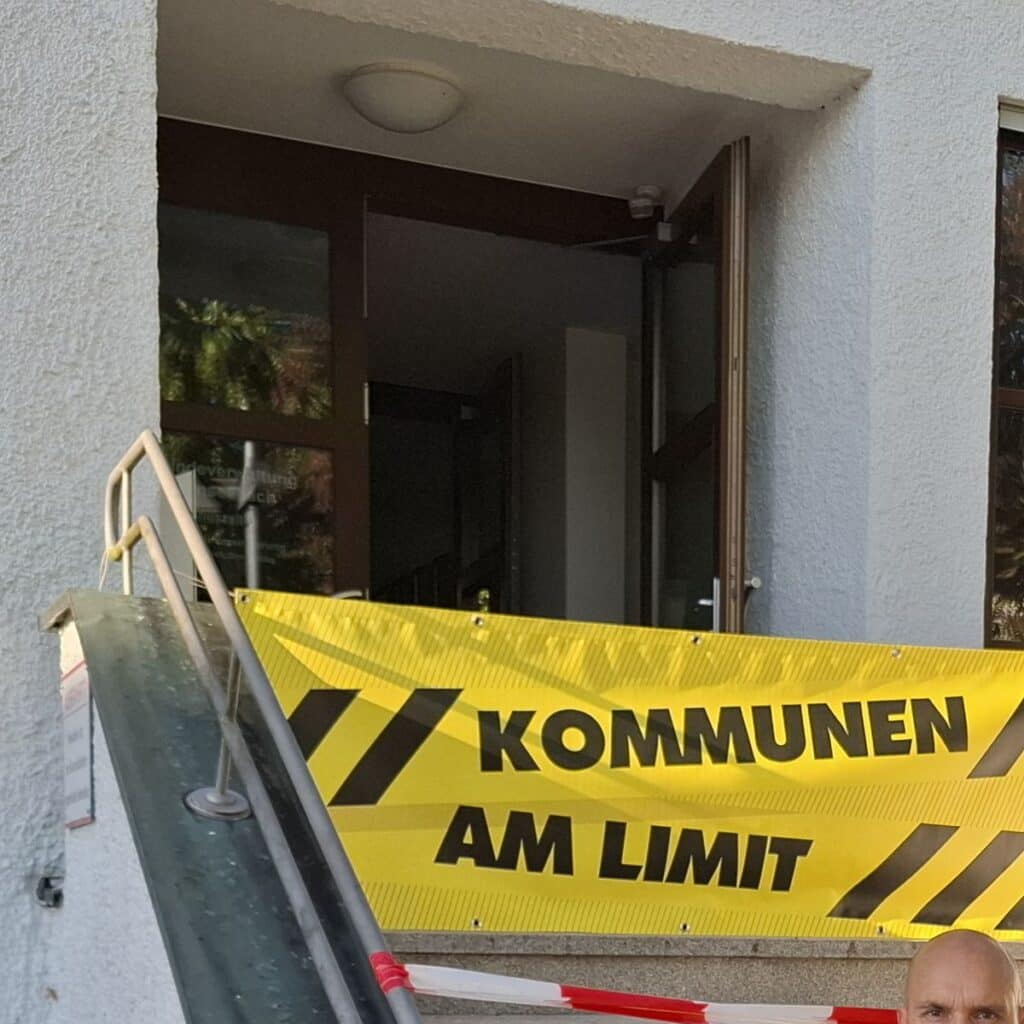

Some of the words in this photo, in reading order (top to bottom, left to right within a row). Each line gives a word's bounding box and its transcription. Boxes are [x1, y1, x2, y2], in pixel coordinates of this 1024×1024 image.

[477, 695, 969, 772] KOMMUNEN
[433, 804, 575, 876] AM
[598, 820, 814, 892] LIMIT
